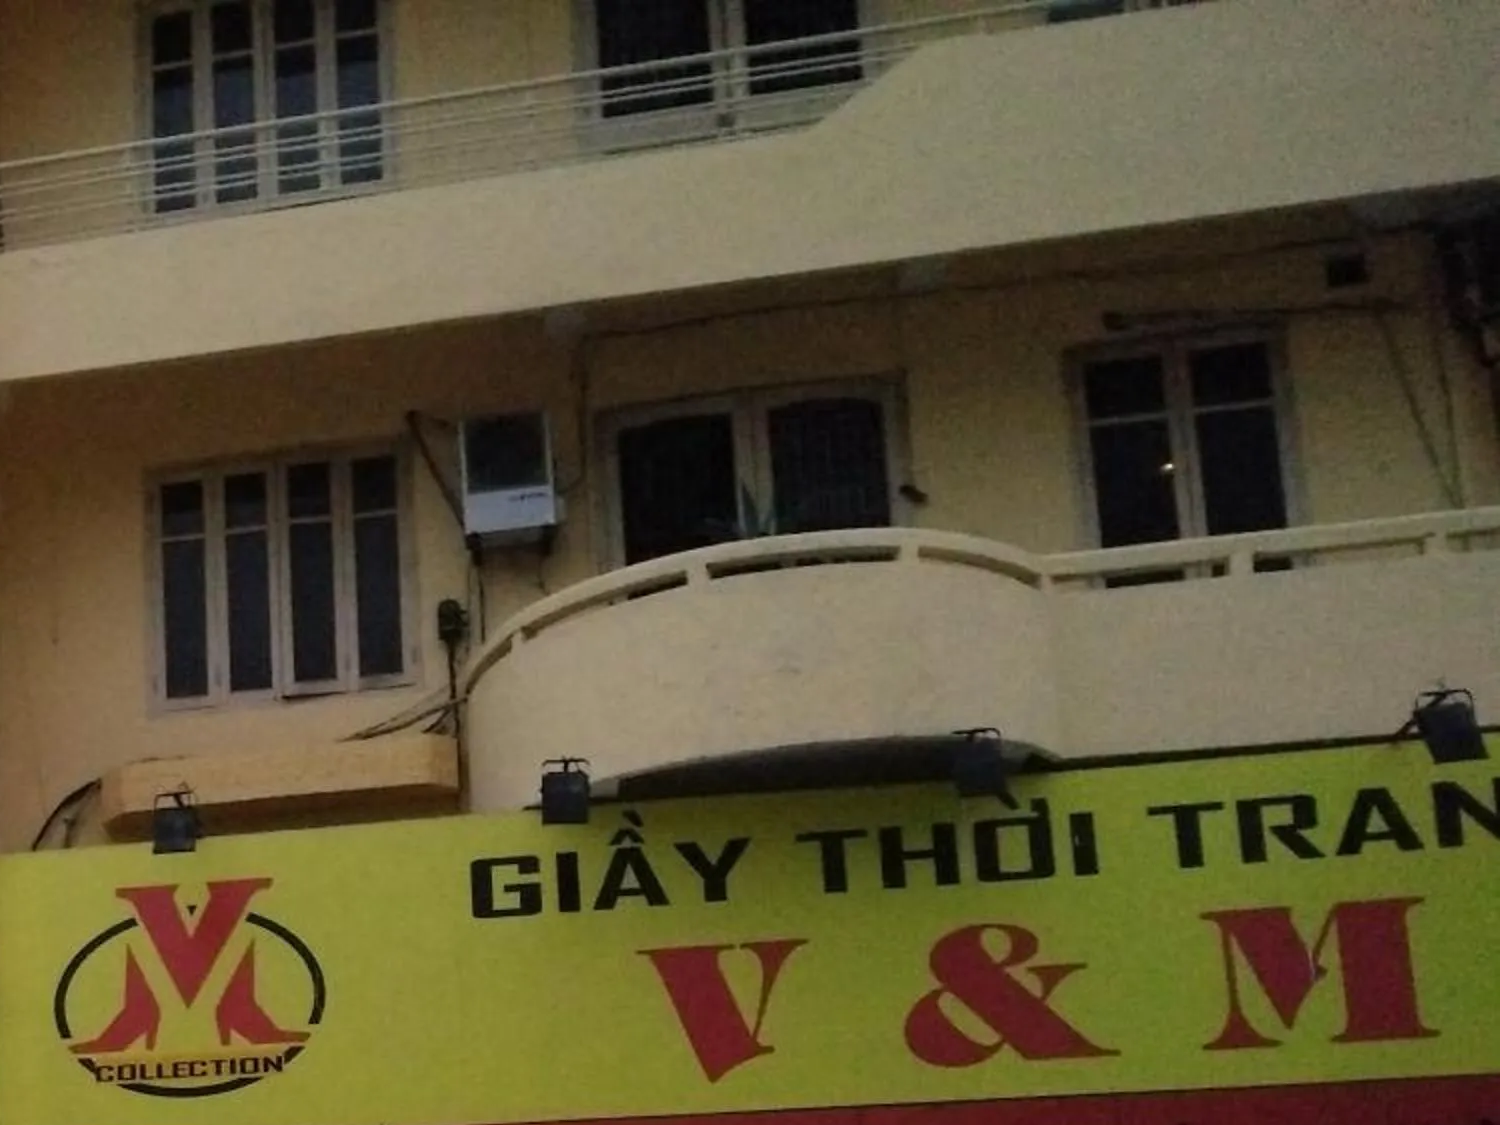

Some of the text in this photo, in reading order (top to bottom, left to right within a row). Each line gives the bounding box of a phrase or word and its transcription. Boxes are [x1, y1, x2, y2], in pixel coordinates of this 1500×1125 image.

[470, 810, 752, 919] GIẦY
[795, 797, 1100, 894] THỜI
[635, 895, 1442, 1084] V & M
[95, 1056, 285, 1083] COLLECTION
